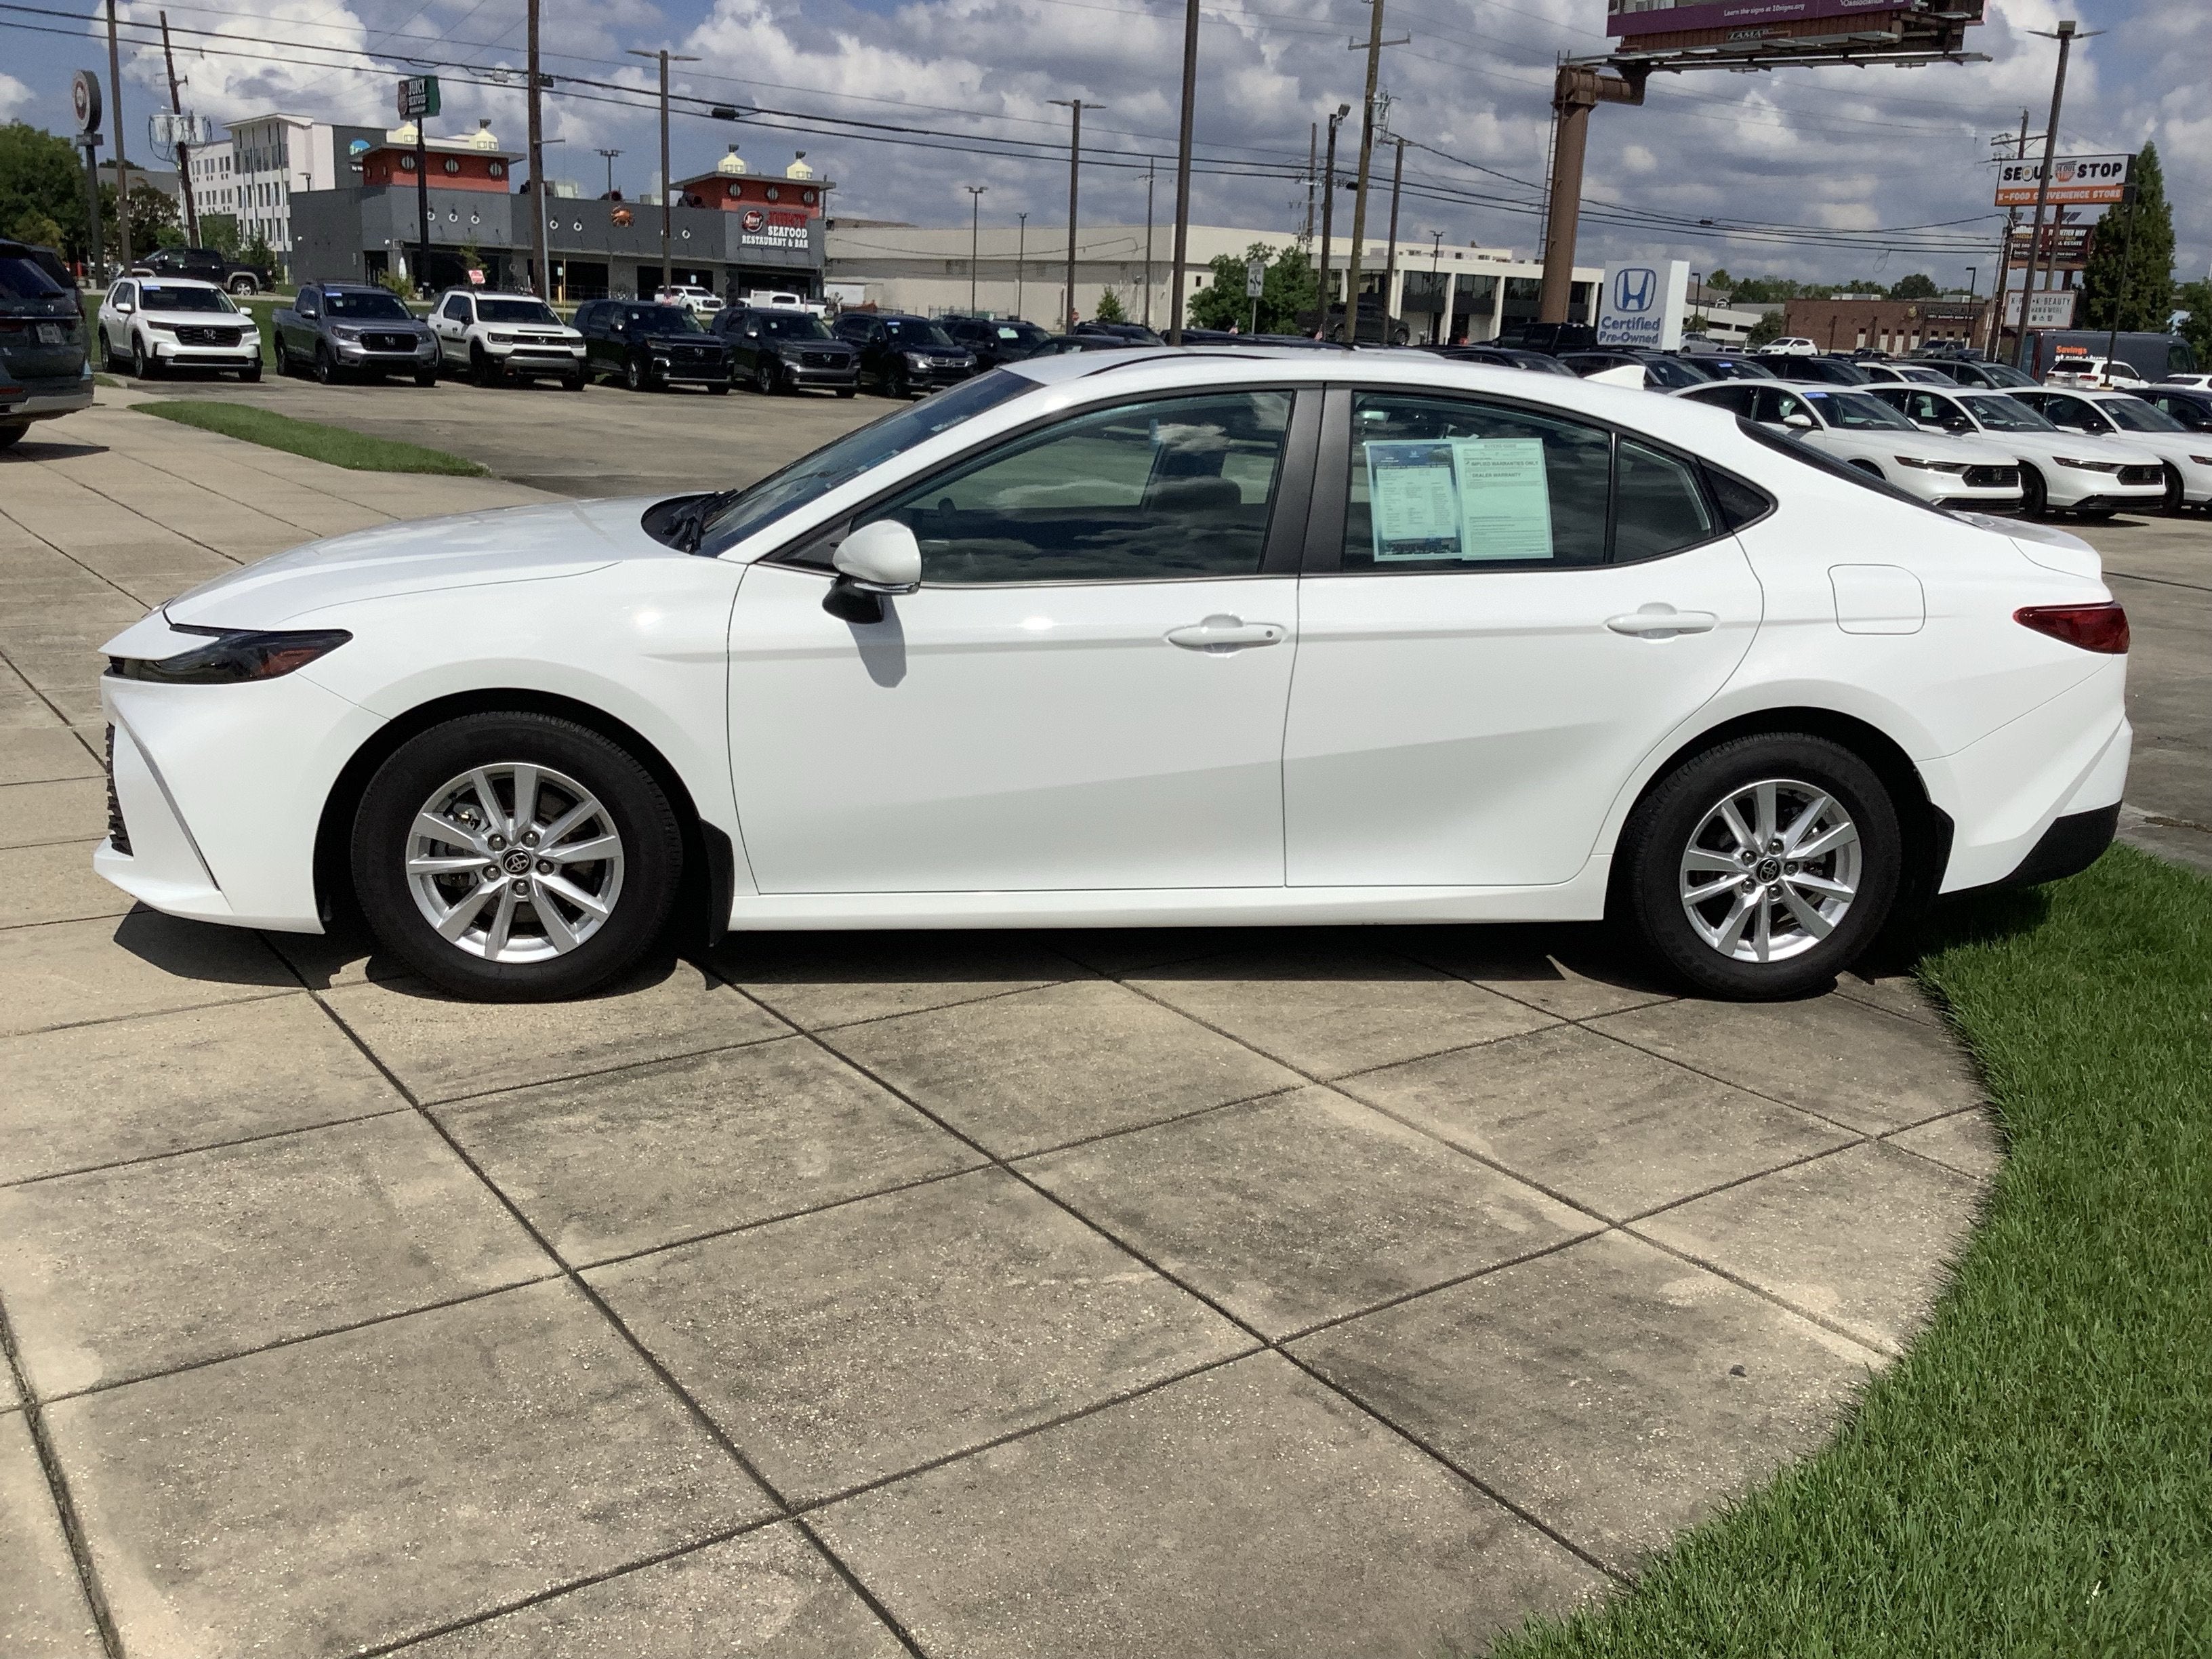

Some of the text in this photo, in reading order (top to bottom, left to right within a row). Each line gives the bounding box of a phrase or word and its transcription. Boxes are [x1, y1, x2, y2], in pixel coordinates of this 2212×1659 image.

[1750, 7, 1765, 15] signs
[408, 78, 426, 96] JUICY
[2003, 162, 2123, 182] SEOU STOP
[1999, 188, 2121, 201] K-FOOD CVENIENCE STORE
[766, 211, 808, 228] JUICY
[767, 225, 808, 239] SEAFOOD
[741, 234, 808, 249] RESTAURANT & BAR
[1601, 316, 1661, 331] Certified
[1599, 331, 1659, 344] Pre-Owned
[2055, 346, 2087, 355] Savings
[2055, 354, 2064, 362] at
